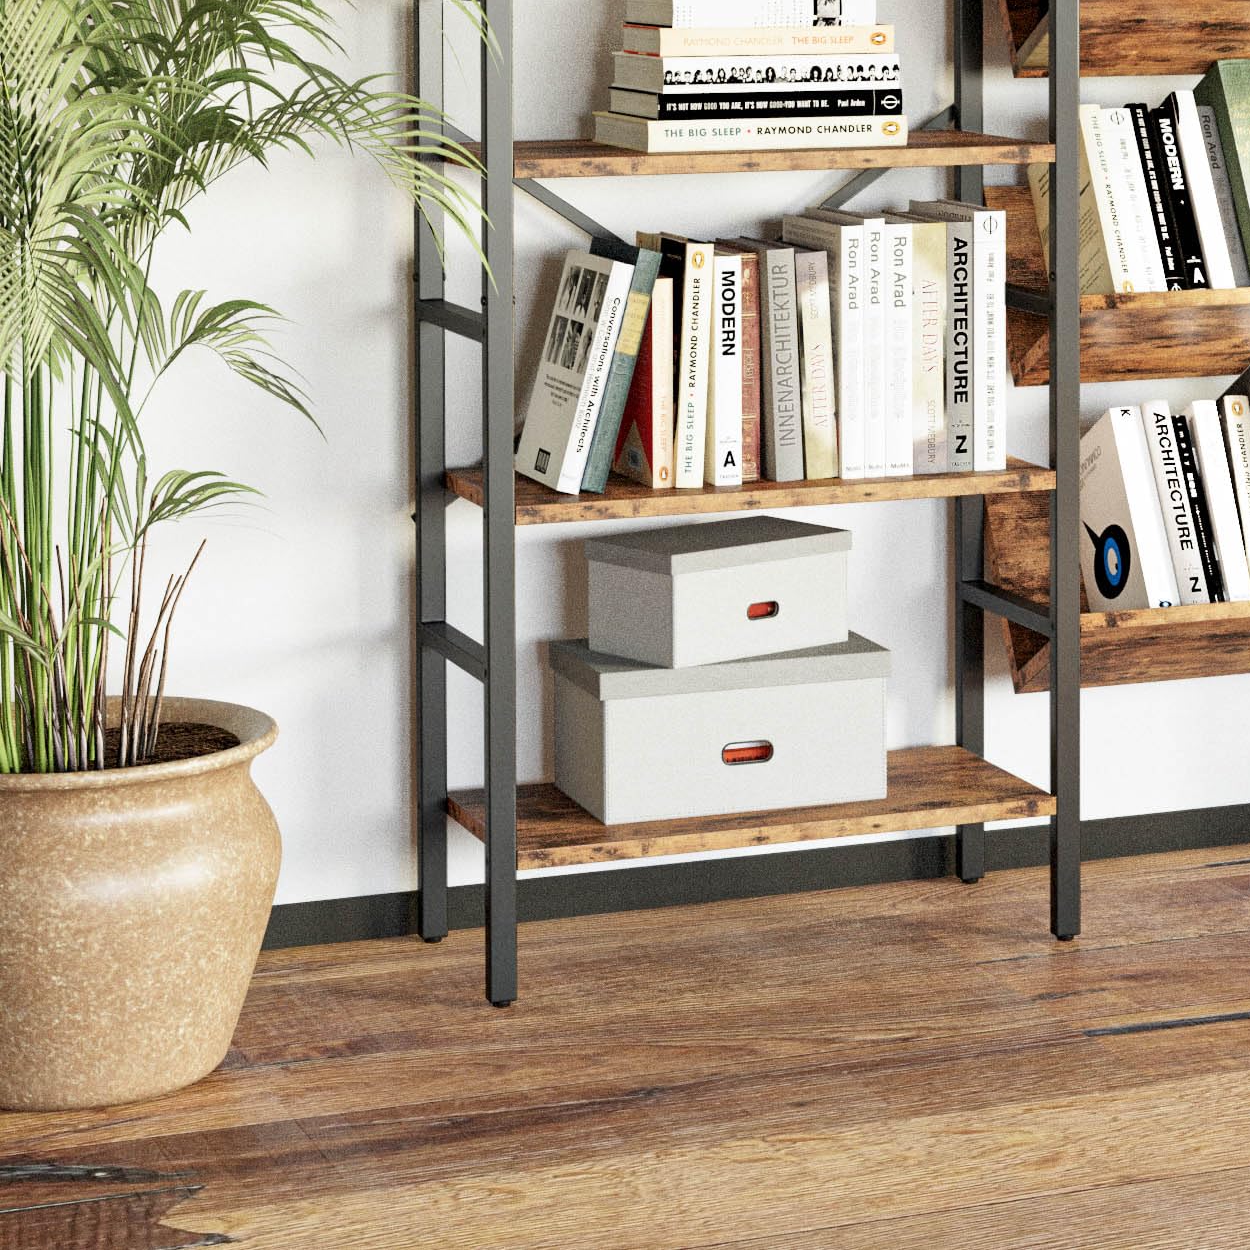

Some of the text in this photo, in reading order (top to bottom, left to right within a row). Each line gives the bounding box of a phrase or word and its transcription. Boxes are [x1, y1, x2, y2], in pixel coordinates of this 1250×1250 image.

[791, 36, 808, 46] THE
[811, 35, 827, 45] BIG
[829, 34, 854, 45] SLEEP
[664, 123, 873, 139] THE BIG SLEEP RAYMOND CHANDLER
[1157, 116, 1185, 191] MODERN
[1199, 113, 1221, 170] Ron Arad
[1103, 182, 1120, 226] RAYMOND
[1112, 228, 1130, 274] CHANDLER
[848, 238, 859, 310] Ron Arad
[870, 231, 881, 305] Ron Arad
[894, 236, 907, 308] Ron Arad
[721, 270, 736, 357] MODERN
[953, 237, 969, 405] ARCHITECTURE
[575, 296, 621, 454] Conversations with Architects
[684, 277, 701, 473] THE BIG SLEEP RAYMOND CHANDLER
[771, 263, 797, 448] INNENARCHITEKTUR
[723, 450, 736, 467] A
[955, 435, 967, 454] N
[1153, 412, 1193, 550] ARCHITECTURE
[1236, 422, 1249, 468] CHANDLER
[1189, 576, 1202, 593] N
